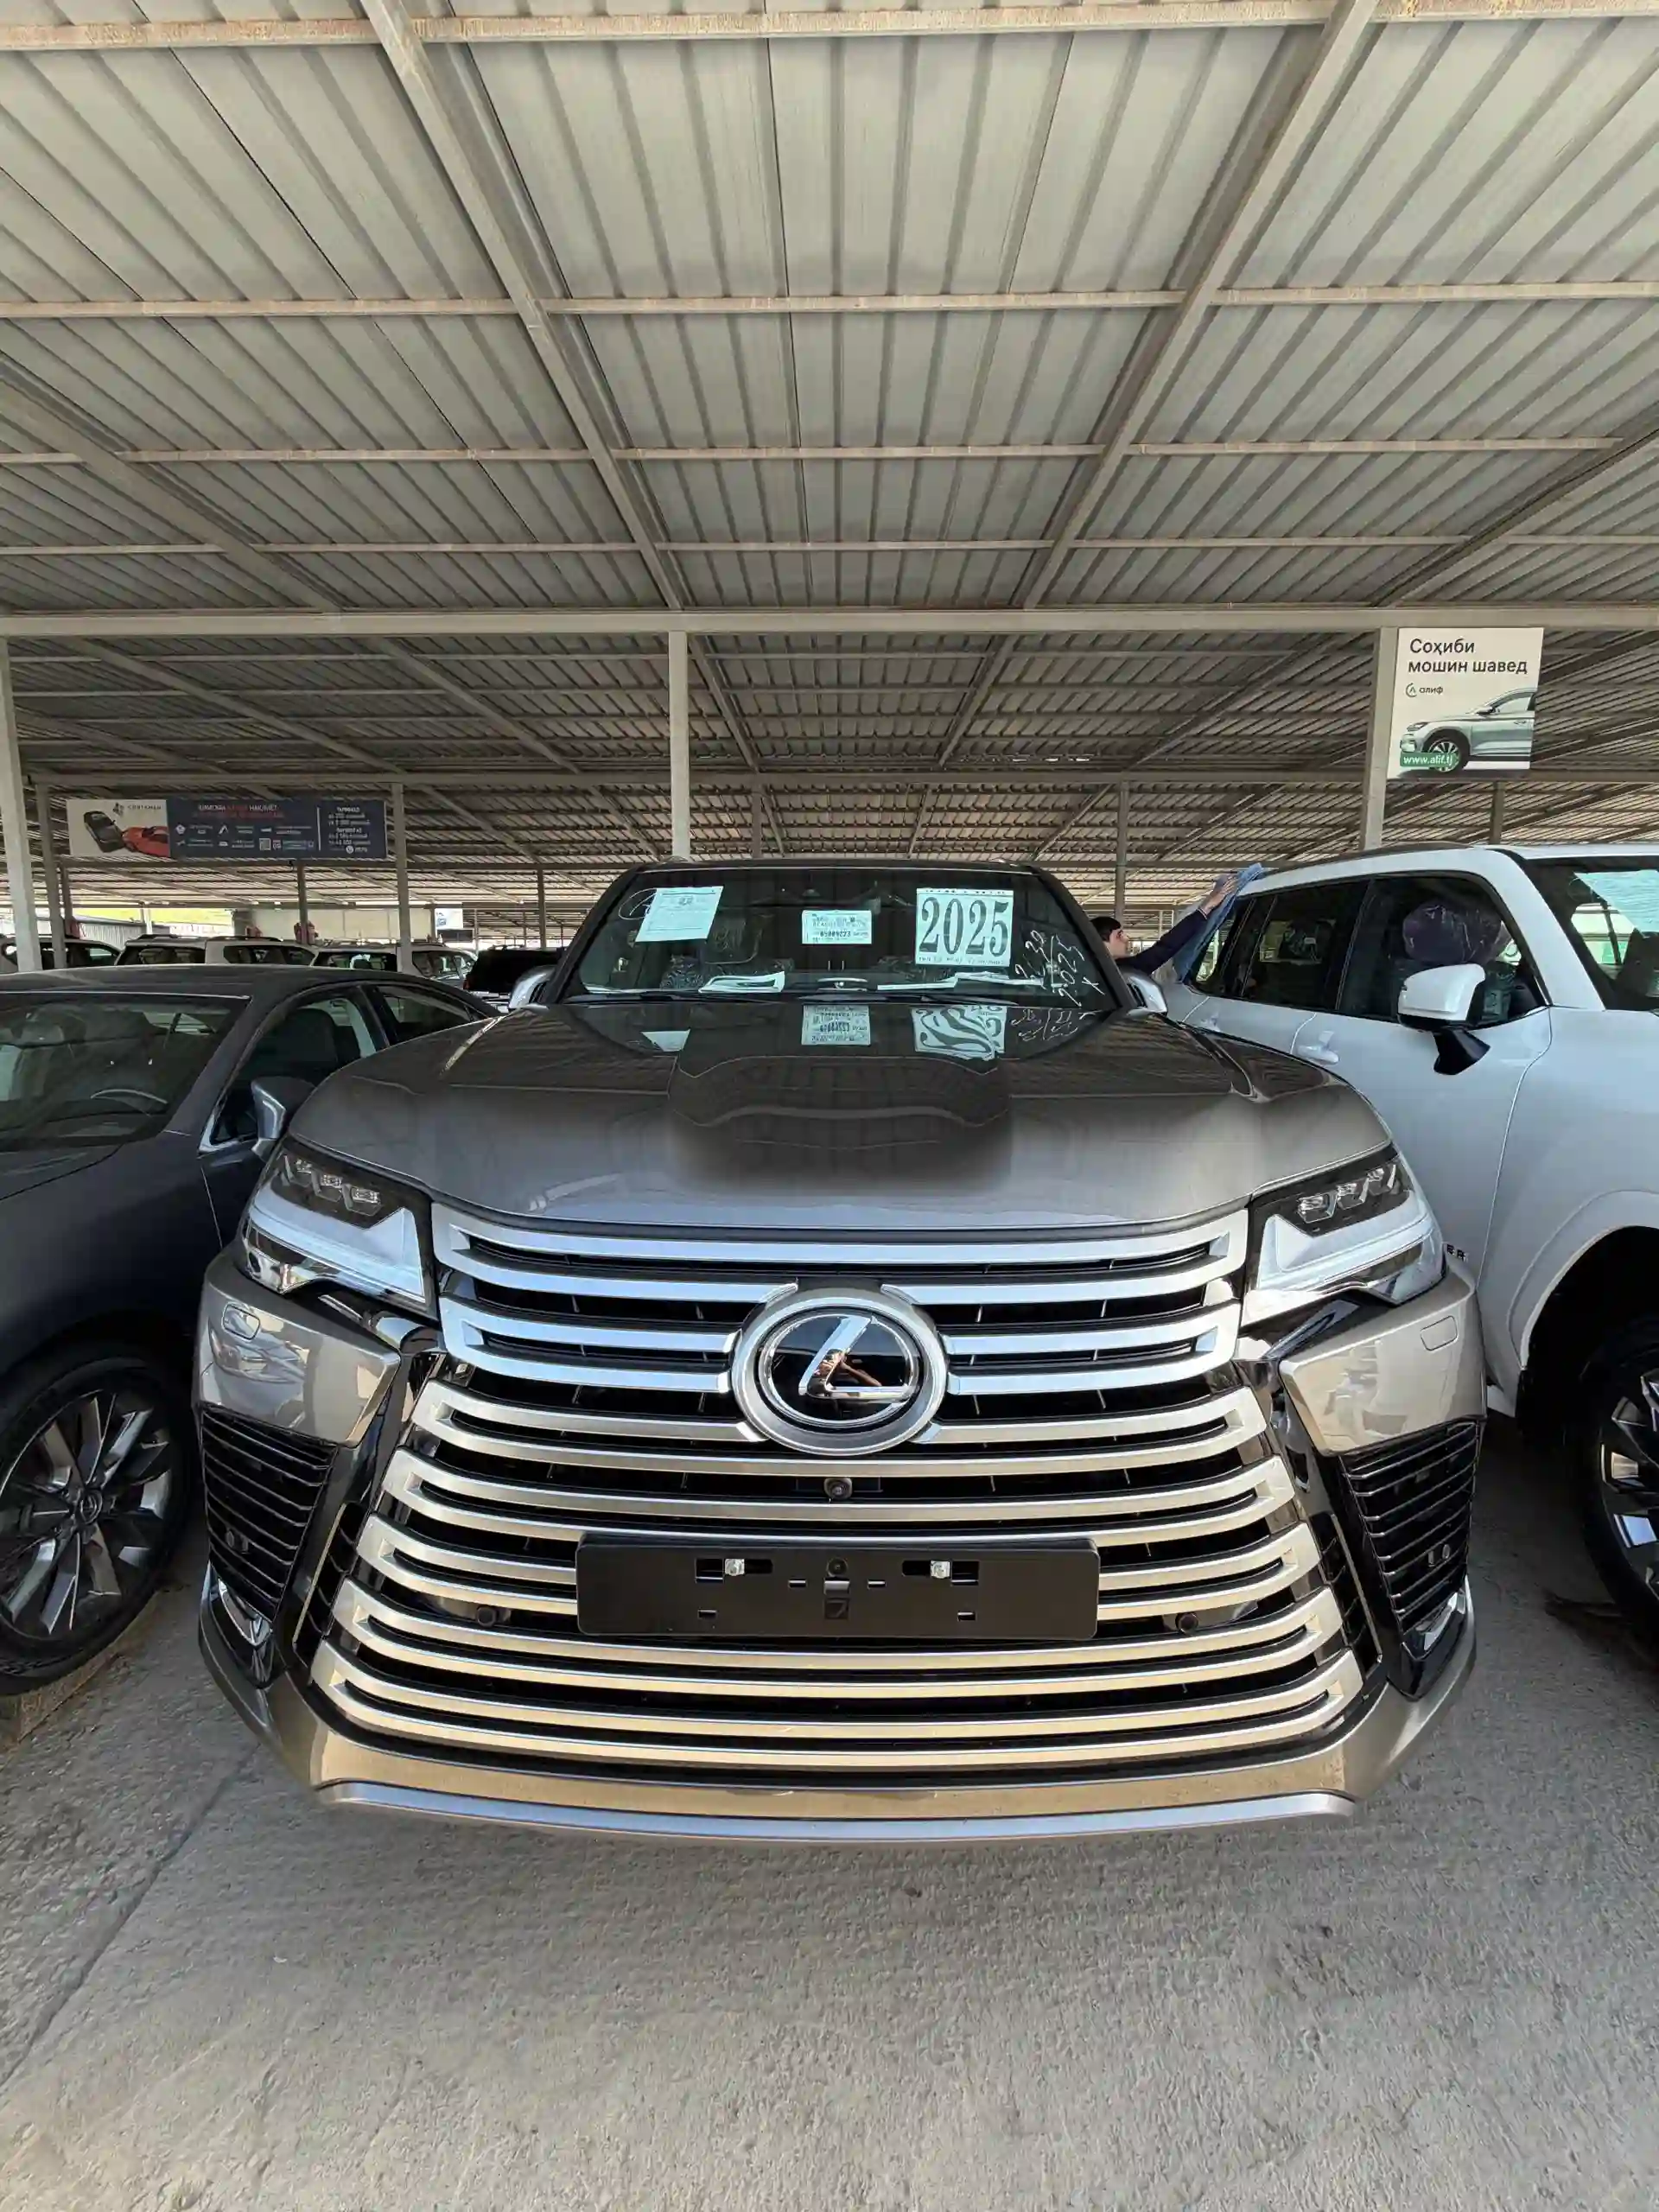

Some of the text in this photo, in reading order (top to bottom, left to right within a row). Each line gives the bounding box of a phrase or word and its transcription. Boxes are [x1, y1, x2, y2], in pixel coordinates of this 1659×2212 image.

[1409, 638, 1476, 655] Соҳиби
[1408, 660, 1528, 674] мошин шавед
[918, 896, 1009, 957] 2025
